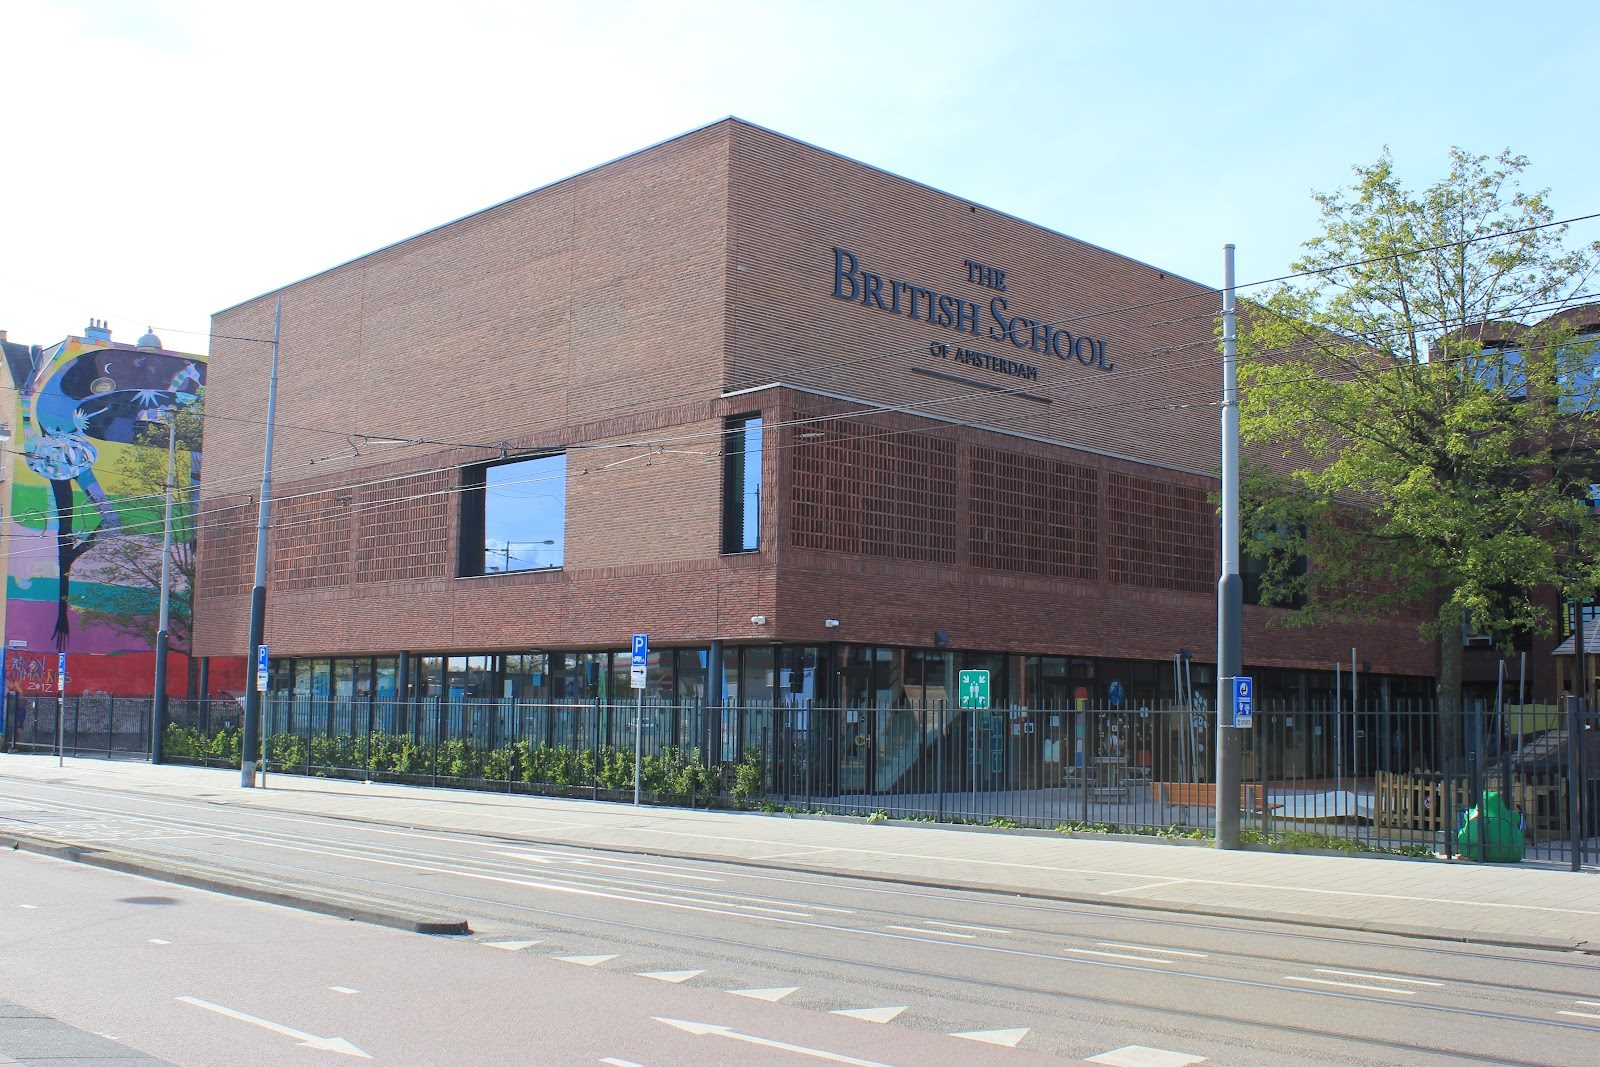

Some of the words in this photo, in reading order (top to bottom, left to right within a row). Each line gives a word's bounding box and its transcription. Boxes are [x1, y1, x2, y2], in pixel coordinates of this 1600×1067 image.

[964, 259, 1007, 292] THE
[831, 246, 981, 337] BRITISH
[990, 296, 1115, 371] SCHOOL
[930, 341, 951, 359] OF
[955, 347, 1037, 381] AMSTERDAM
[260, 648, 266, 662] P
[635, 637, 644, 653] P
[27, 682, 54, 693] 2012
